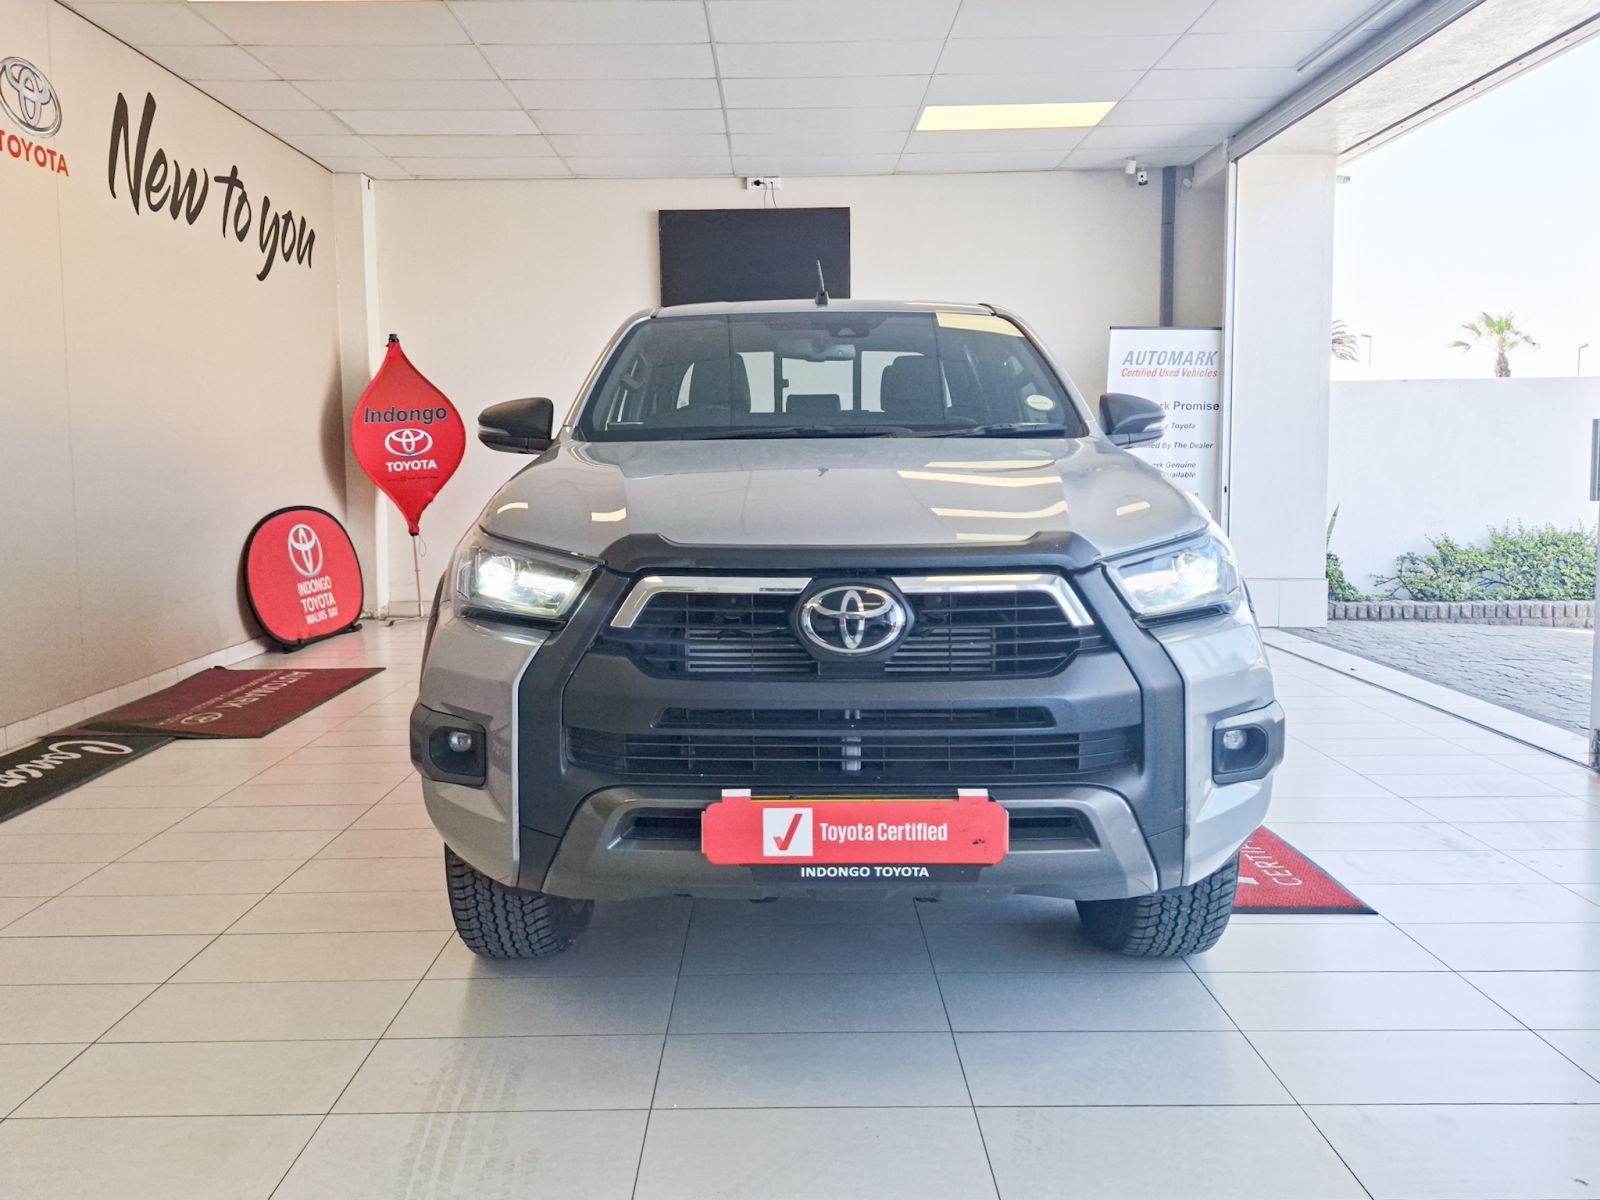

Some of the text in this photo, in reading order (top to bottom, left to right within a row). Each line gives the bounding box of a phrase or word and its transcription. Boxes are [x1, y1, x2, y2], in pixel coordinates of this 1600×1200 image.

[0, 129, 69, 176] TOYOTA
[108, 91, 316, 281] New to you
[1121, 350, 1218, 366] AUTOMARK
[1121, 367, 1218, 378] Certified Used Vehicles
[1173, 400, 1220, 412] Promise
[364, 406, 447, 425] Indongo
[1171, 421, 1197, 431] Toyota
[1174, 441, 1188, 449] The
[1189, 441, 1214, 449] Dealer
[385, 459, 438, 472] TOYOTA
[1165, 461, 1197, 469] Genuine
[296, 575, 333, 597] INDONGO
[300, 591, 337, 614] TOYOTA
[819, 822, 949, 844] Toyota Certified
[800, 866, 930, 878] INDONGO TOYOTA
